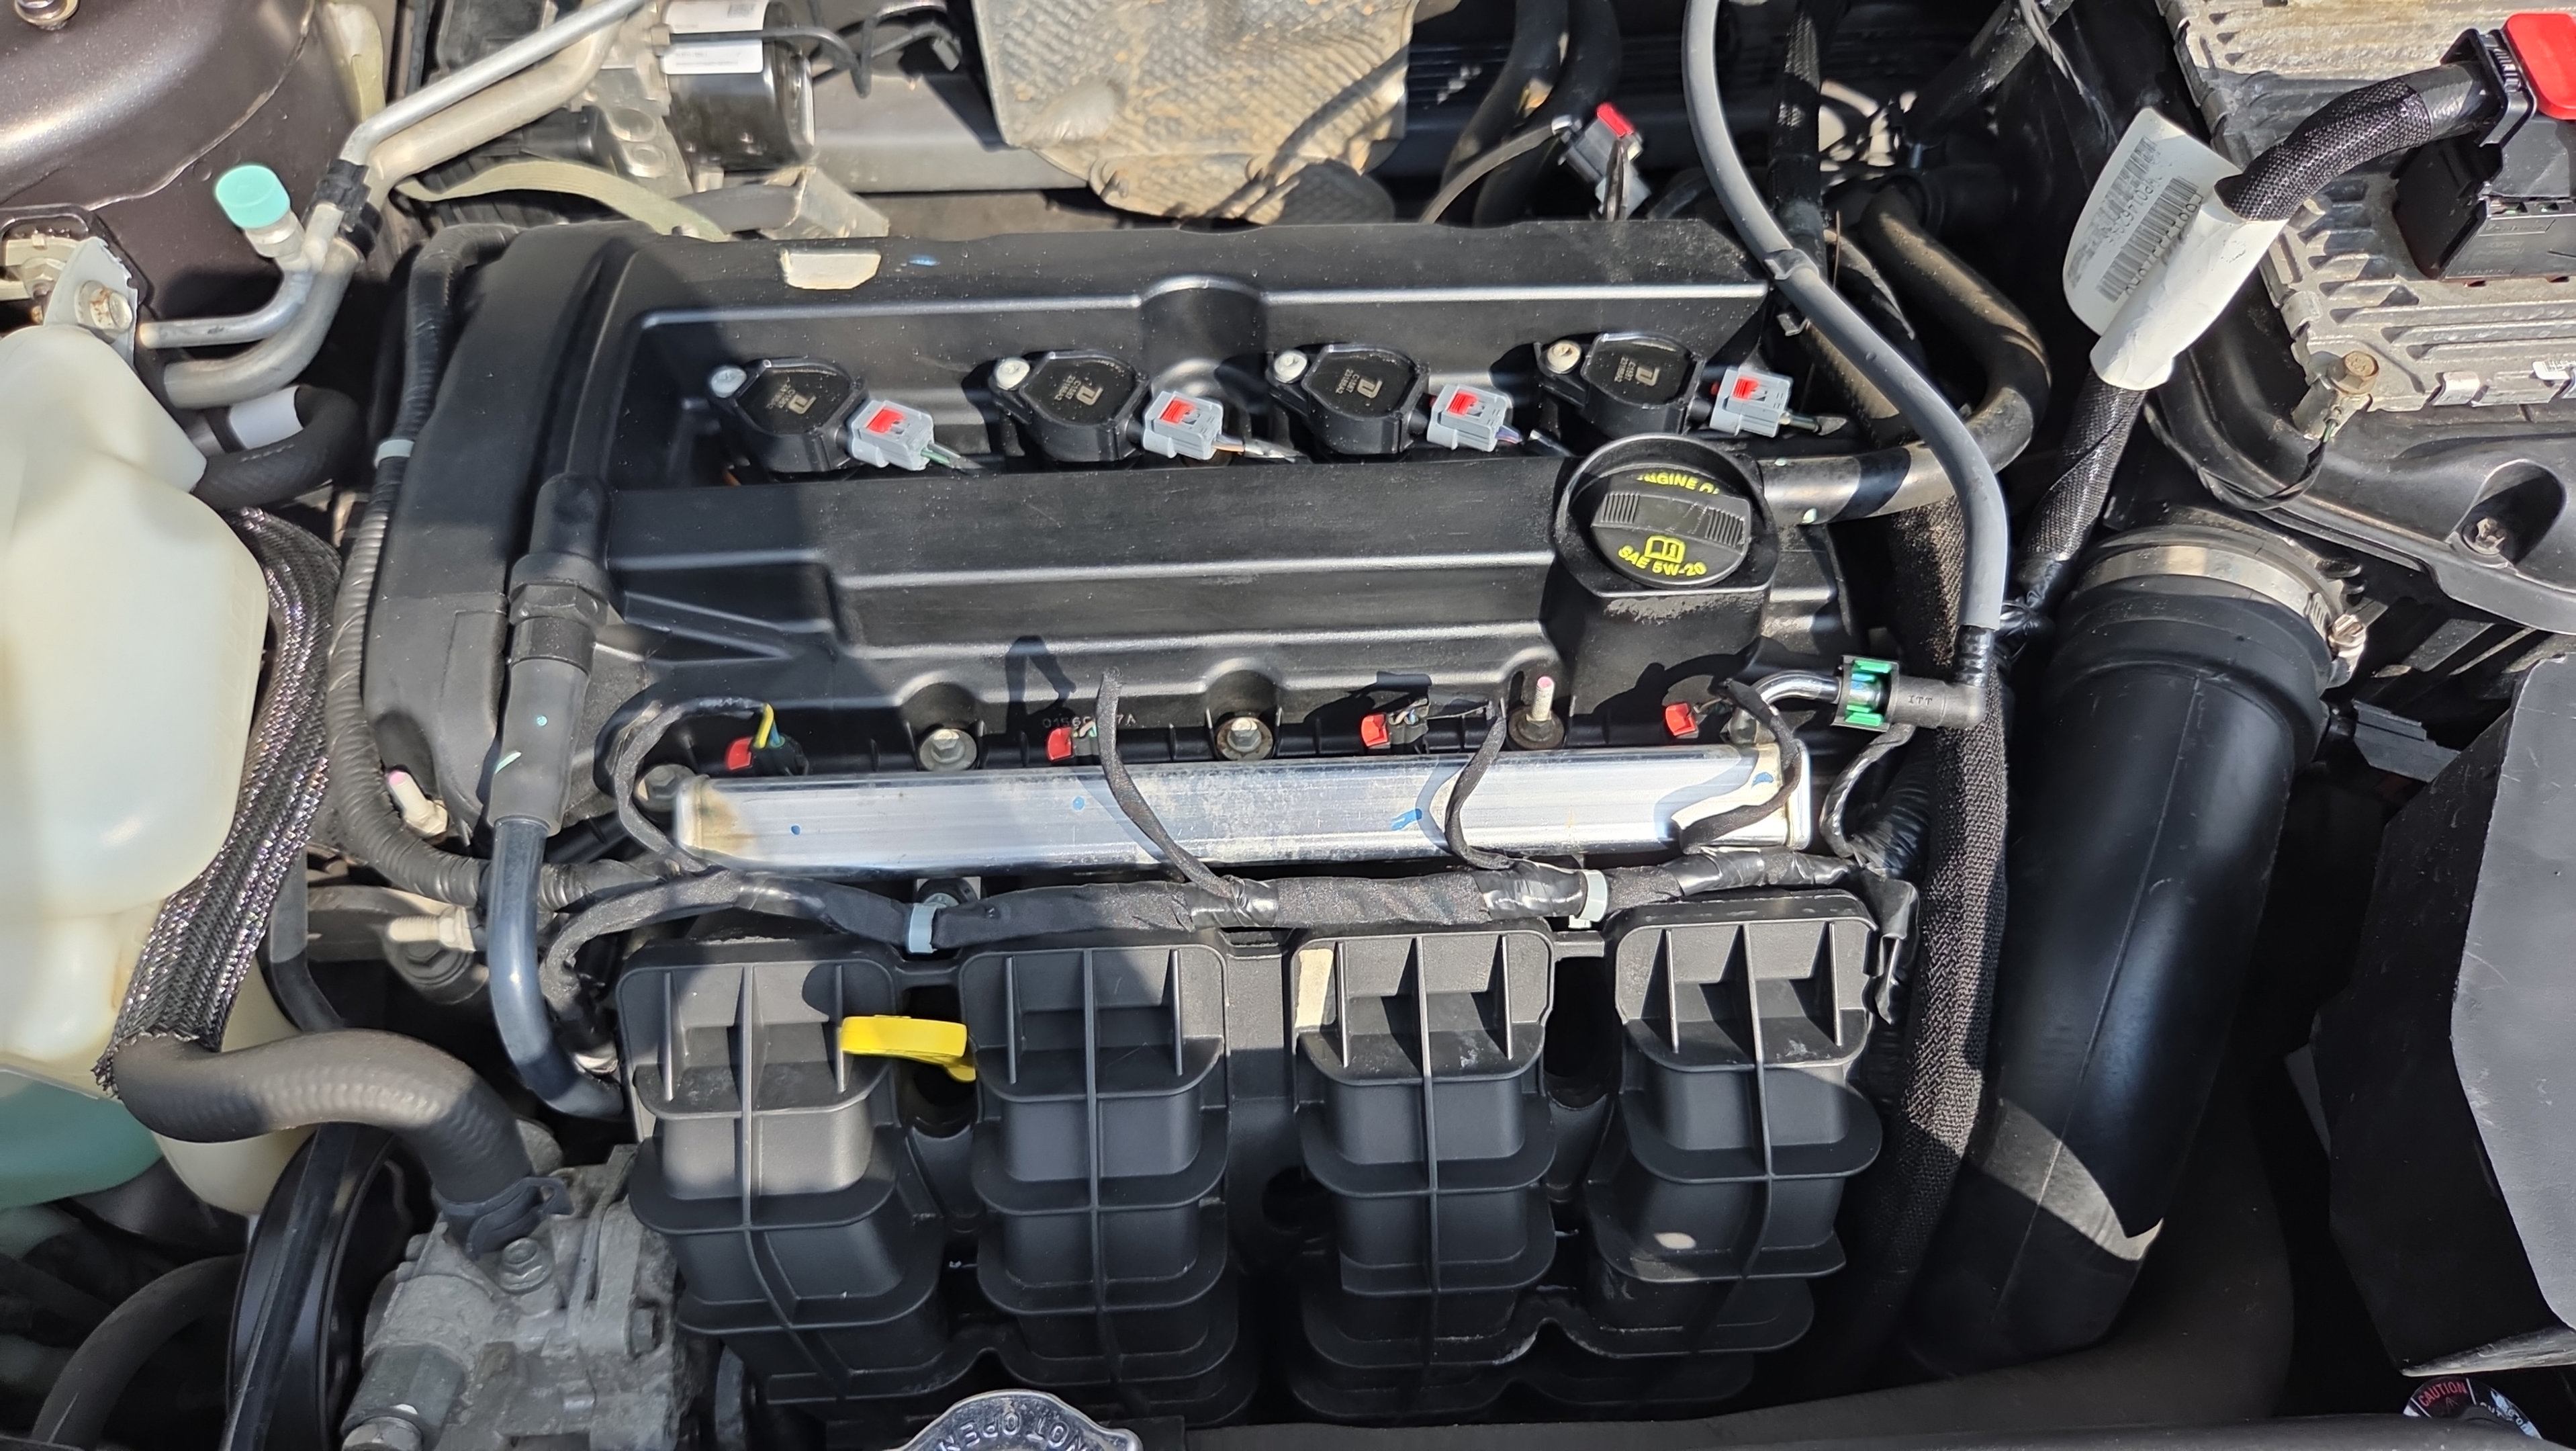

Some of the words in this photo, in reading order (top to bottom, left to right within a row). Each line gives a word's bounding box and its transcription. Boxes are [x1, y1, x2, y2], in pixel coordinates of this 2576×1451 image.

[1636, 472, 1699, 490] NGINE
[1618, 545, 1649, 570] SAE
[1652, 560, 1708, 578] 5W-20
[1907, 694, 1934, 706] ITT
[2418, 1380, 2468, 1407] CAUTION
[937, 1411, 1022, 1451] OPEN
[1027, 1415, 1093, 1451] NOT
